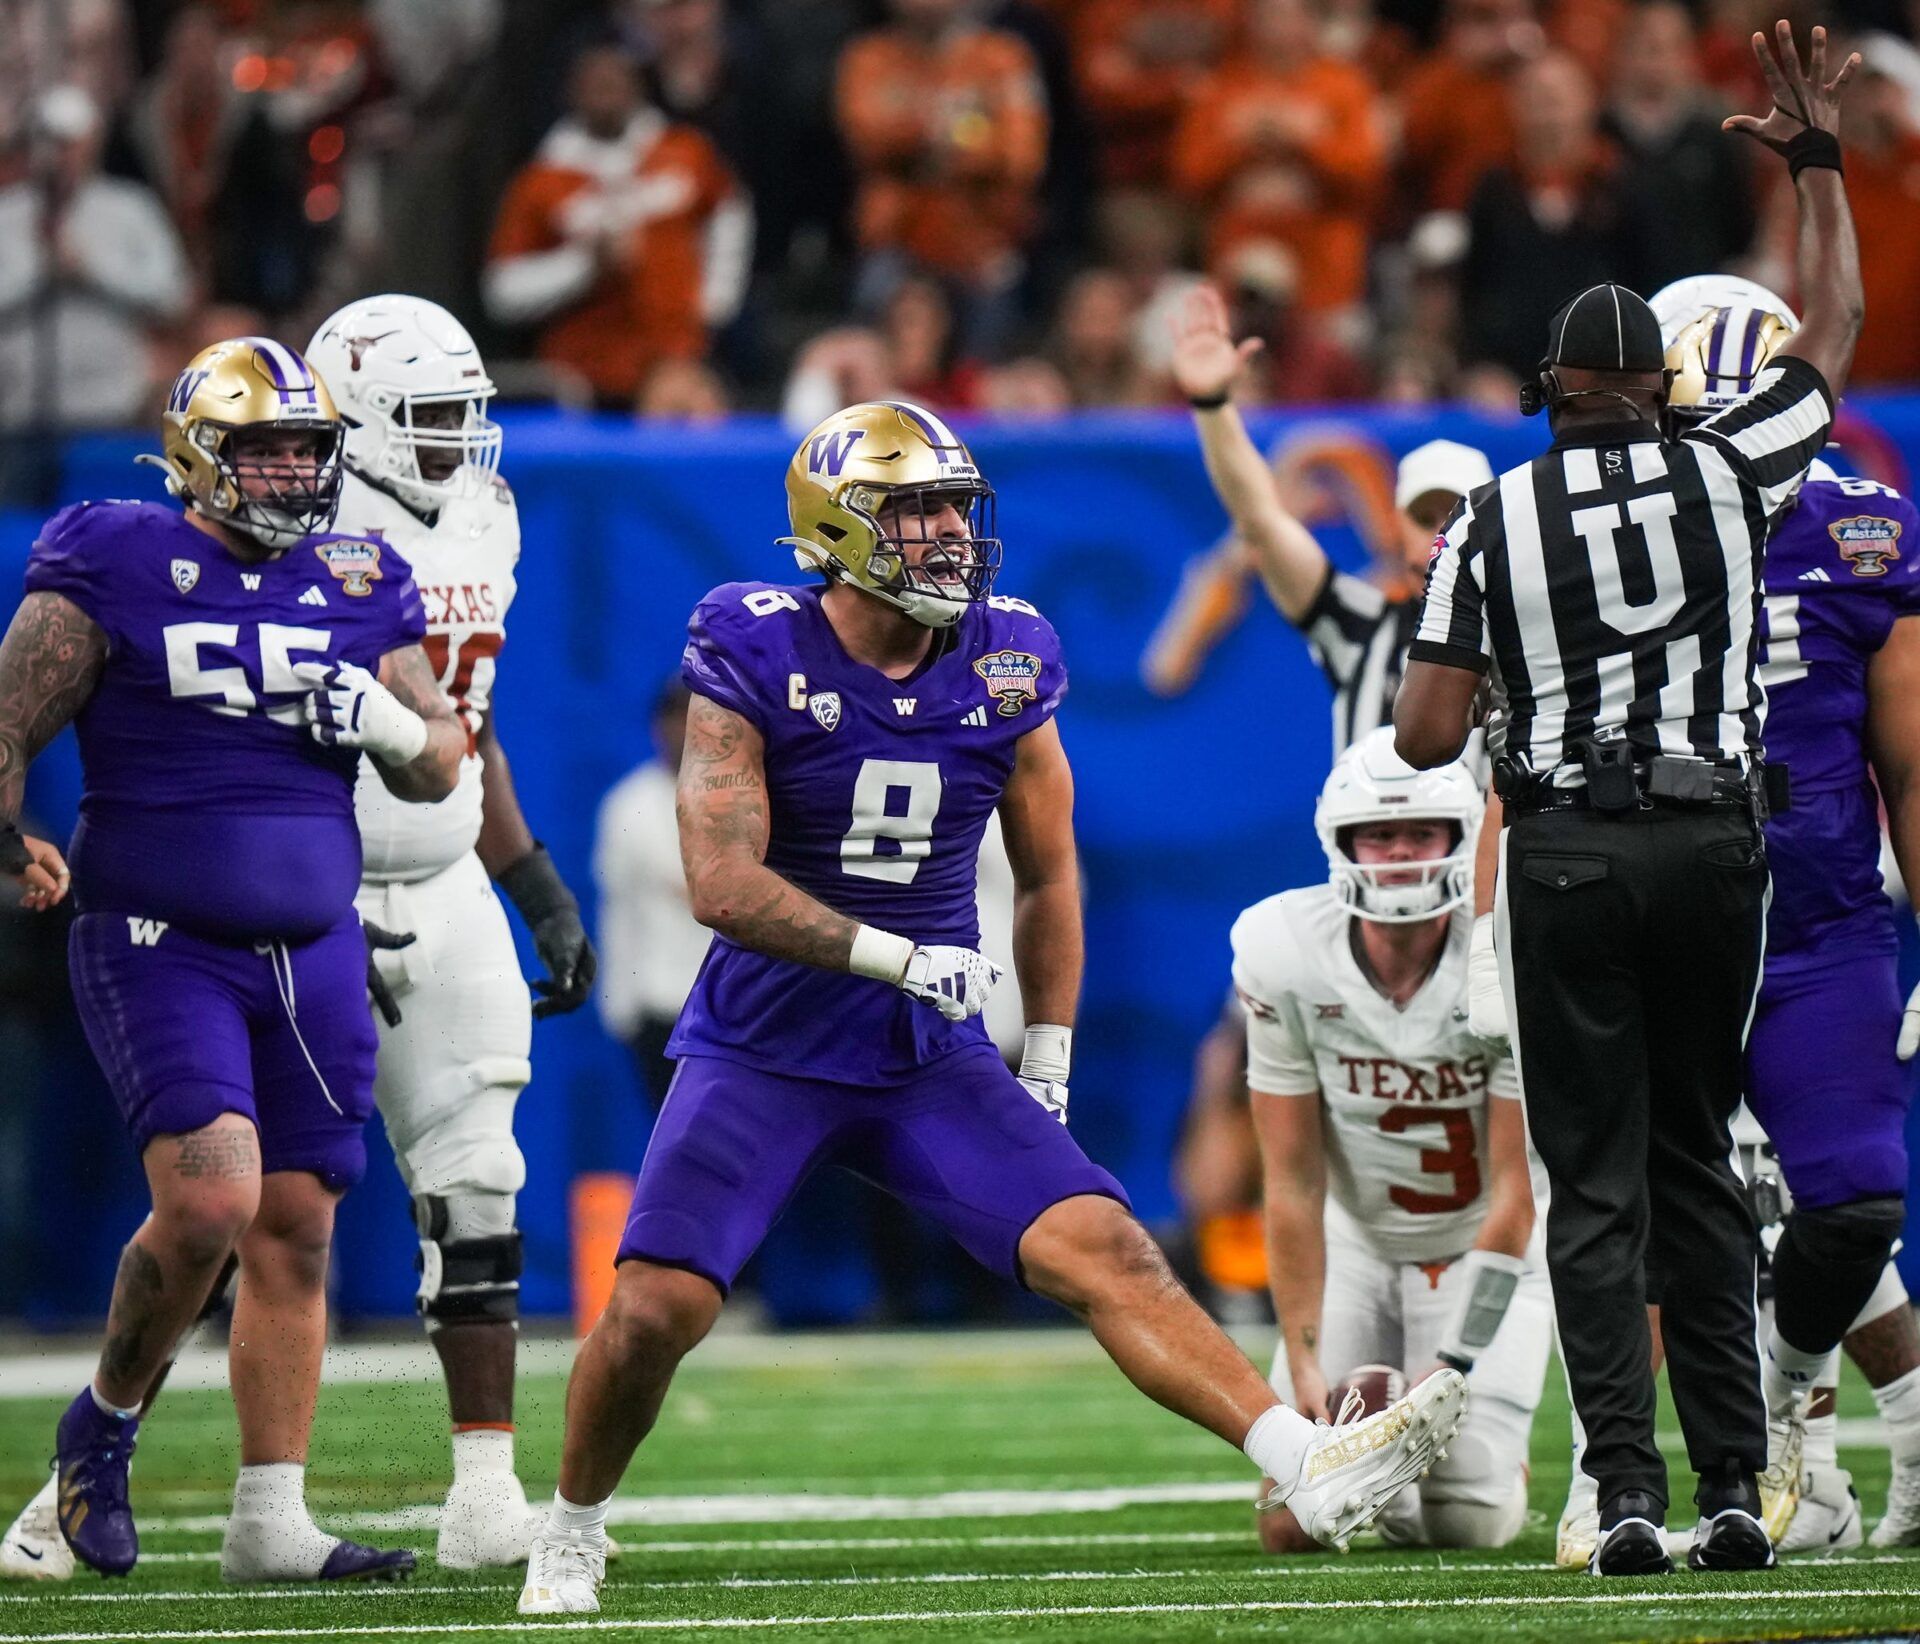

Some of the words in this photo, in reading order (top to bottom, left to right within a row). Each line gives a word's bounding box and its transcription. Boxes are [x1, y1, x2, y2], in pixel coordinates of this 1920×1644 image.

[168, 370, 211, 413] W
[807, 429, 867, 478] W
[949, 466, 976, 475] DAWGS
[1843, 528, 1890, 540] Allstate
[1571, 491, 1687, 636] U
[240, 573, 262, 591] W
[741, 590, 801, 617] 8
[163, 621, 332, 727] 55
[988, 664, 1030, 677] Allstate
[788, 673, 808, 711] C
[810, 693, 839, 718] PAC
[892, 698, 917, 716] W
[820, 708, 836, 724] 12
[840, 758, 942, 885] 8
[126, 915, 169, 947] W
[1338, 1054, 1489, 1101] TEXAS
[1377, 1103, 1482, 1215] 3
